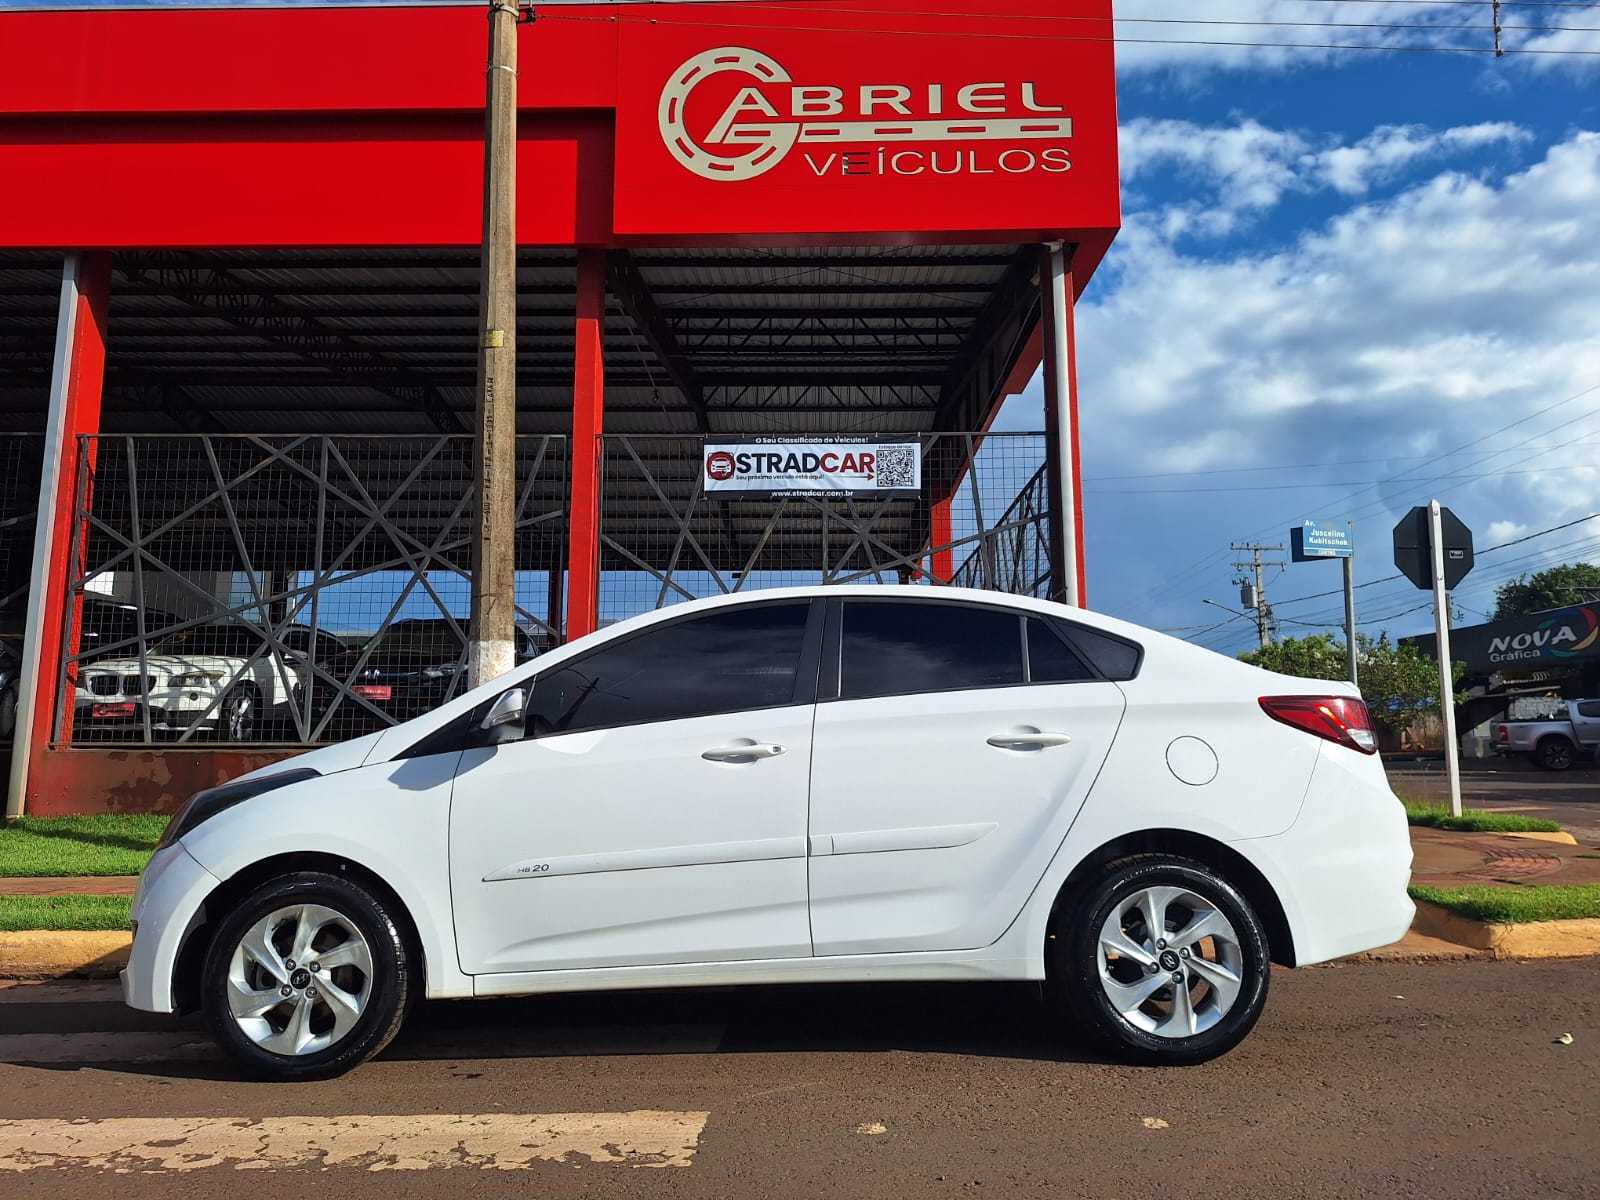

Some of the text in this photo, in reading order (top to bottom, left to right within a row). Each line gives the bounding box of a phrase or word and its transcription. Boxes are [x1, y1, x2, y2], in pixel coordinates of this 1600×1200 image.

[658, 46, 1065, 181] GABRIEL
[803, 146, 1073, 176] VEÍCULOS
[735, 452, 875, 474] STRADCAR
[1488, 626, 1577, 653] NOVA
[1489, 648, 1541, 663] Gráfica
